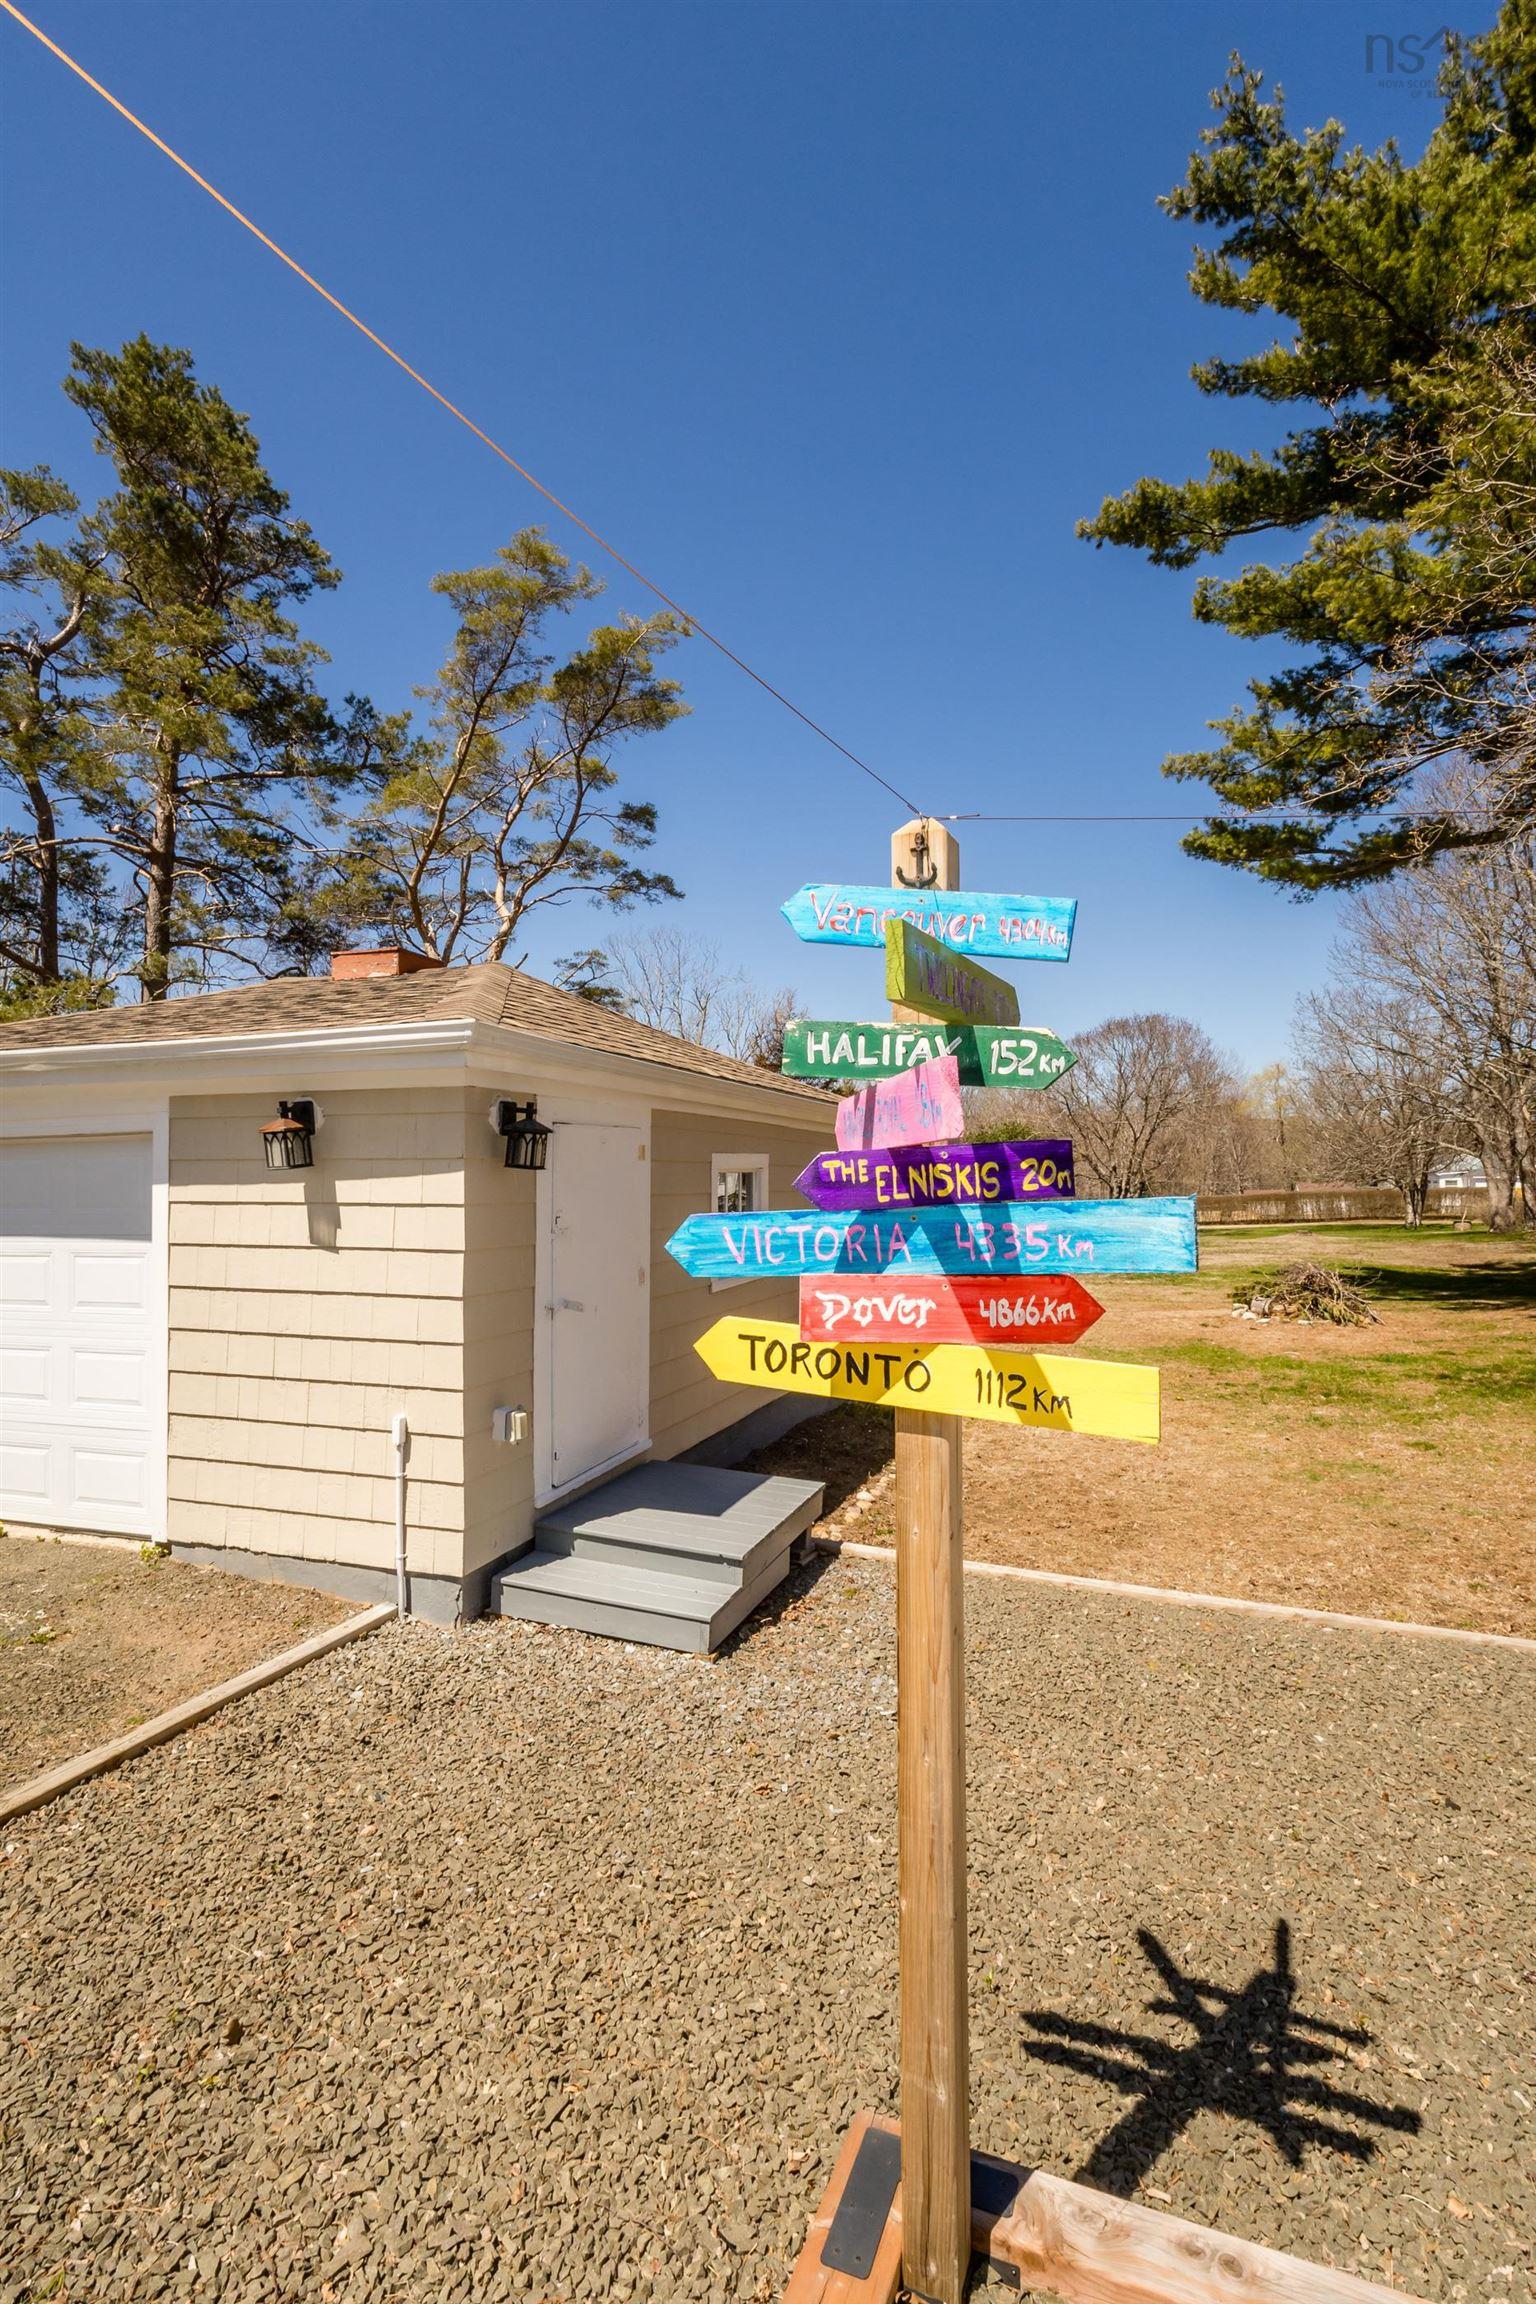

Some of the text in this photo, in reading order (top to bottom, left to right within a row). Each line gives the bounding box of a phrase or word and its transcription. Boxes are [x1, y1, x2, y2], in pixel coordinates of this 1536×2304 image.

[821, 1158, 869, 1184] THE
[722, 1223, 913, 1264] VICTORIA
[953, 1222, 1050, 1262] 4335
[815, 1290, 937, 1331] Dover
[738, 1333, 932, 1393] TORONTO
